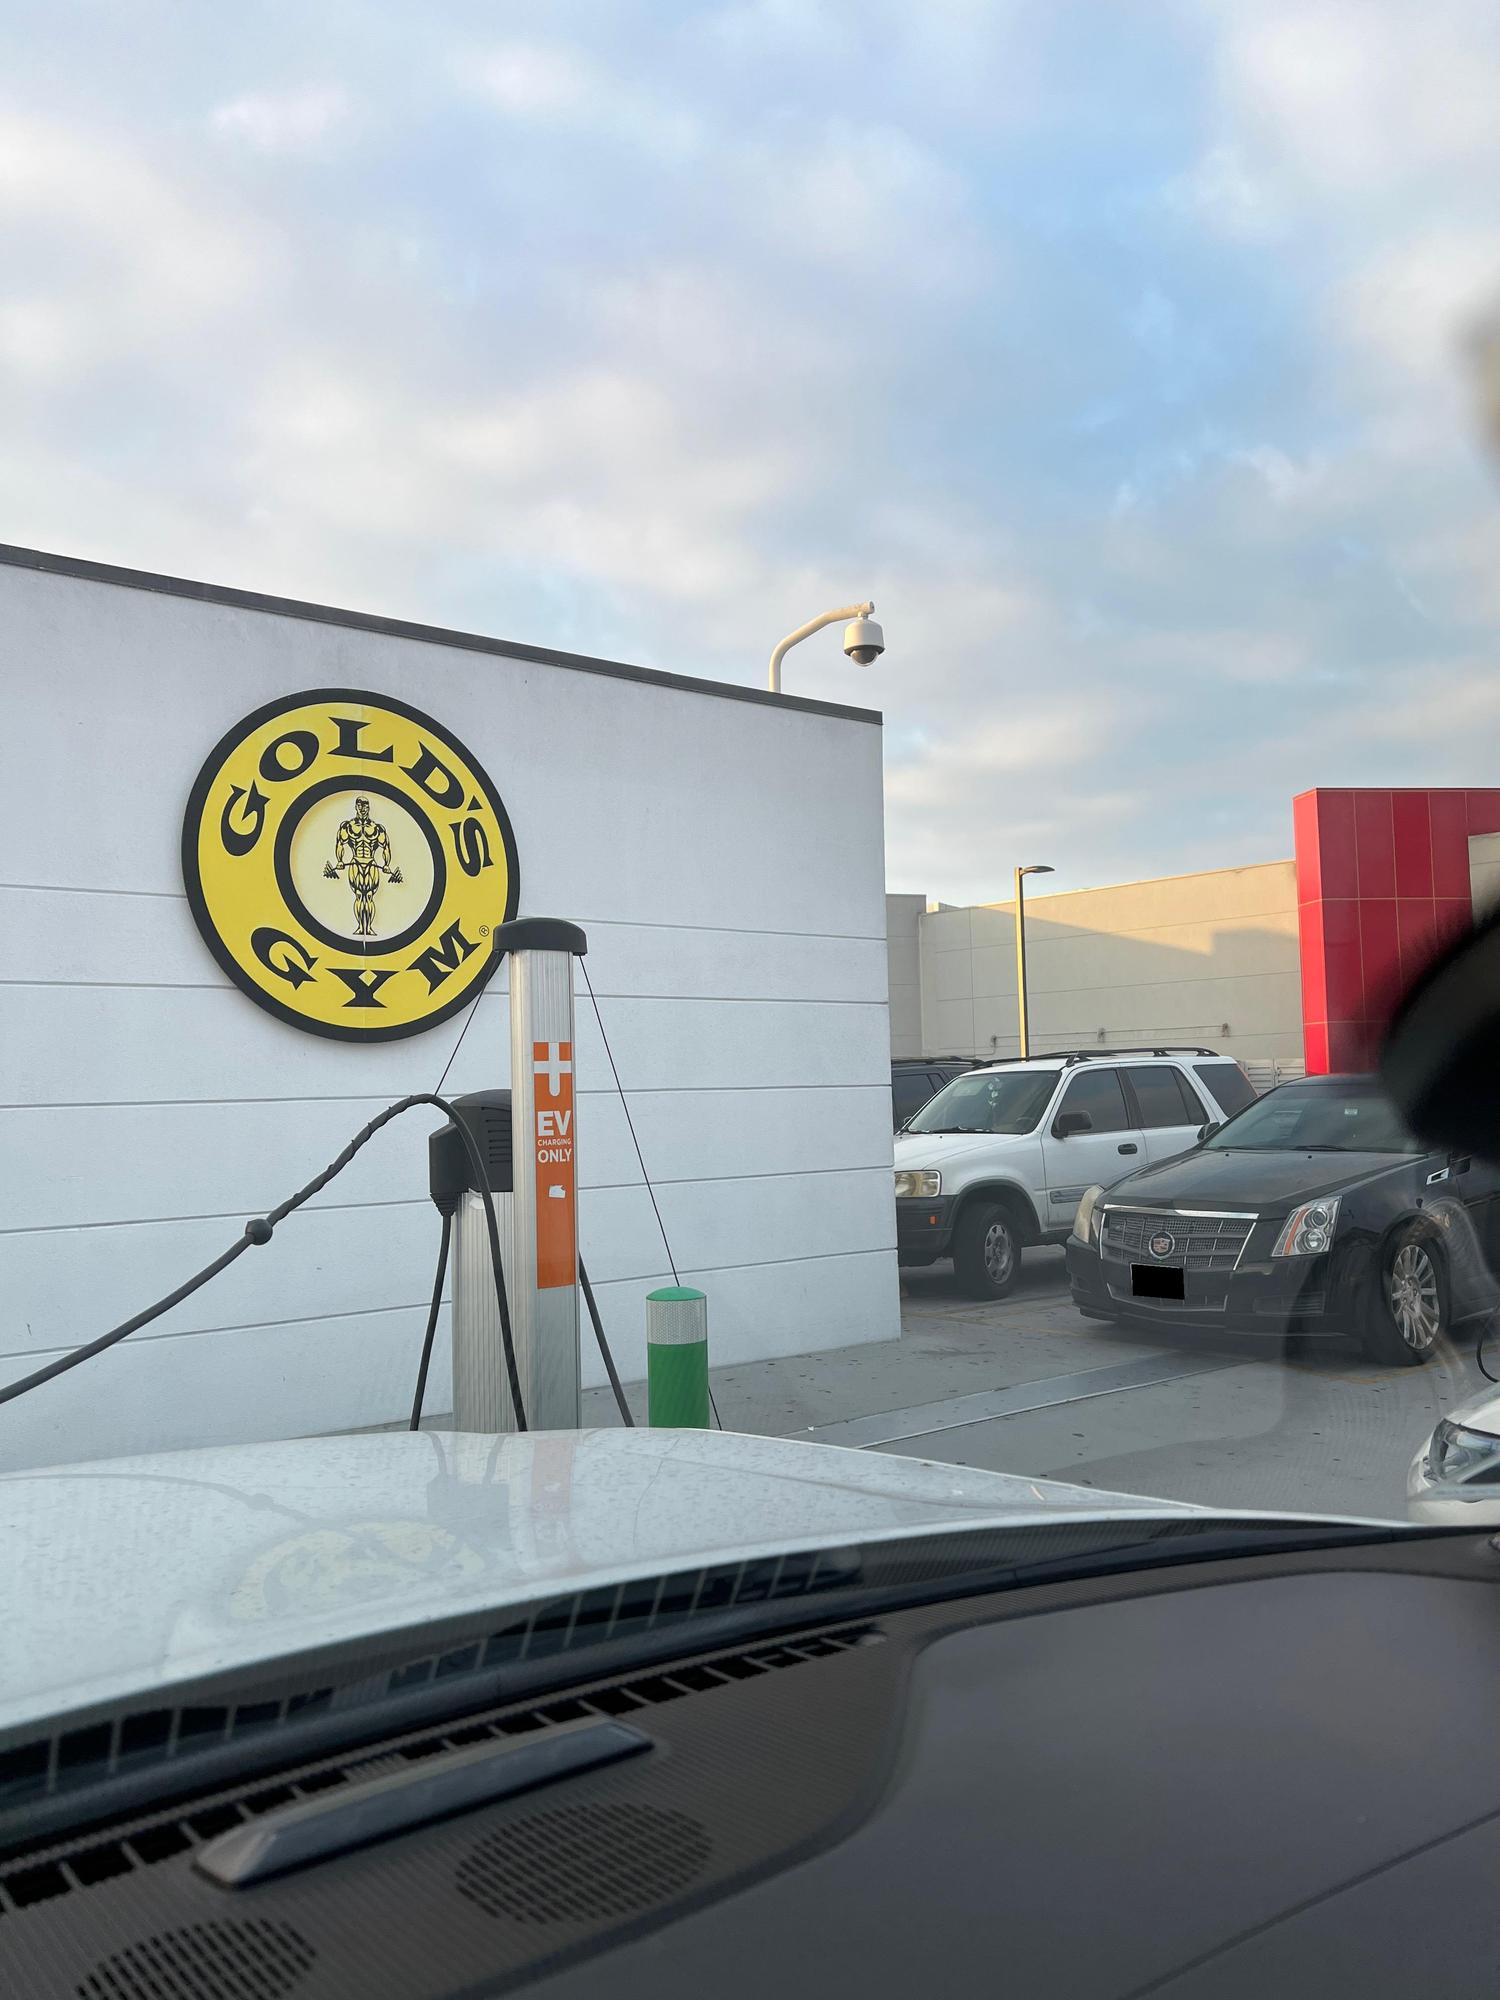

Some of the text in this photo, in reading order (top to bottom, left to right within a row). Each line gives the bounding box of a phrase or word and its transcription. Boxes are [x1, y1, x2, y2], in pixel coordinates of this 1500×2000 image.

[220, 716, 494, 877] GOLD'S
[537, 1110, 572, 1137] EV
[537, 1138, 572, 1147] CHARGING
[537, 1148, 572, 1164] ONLY
